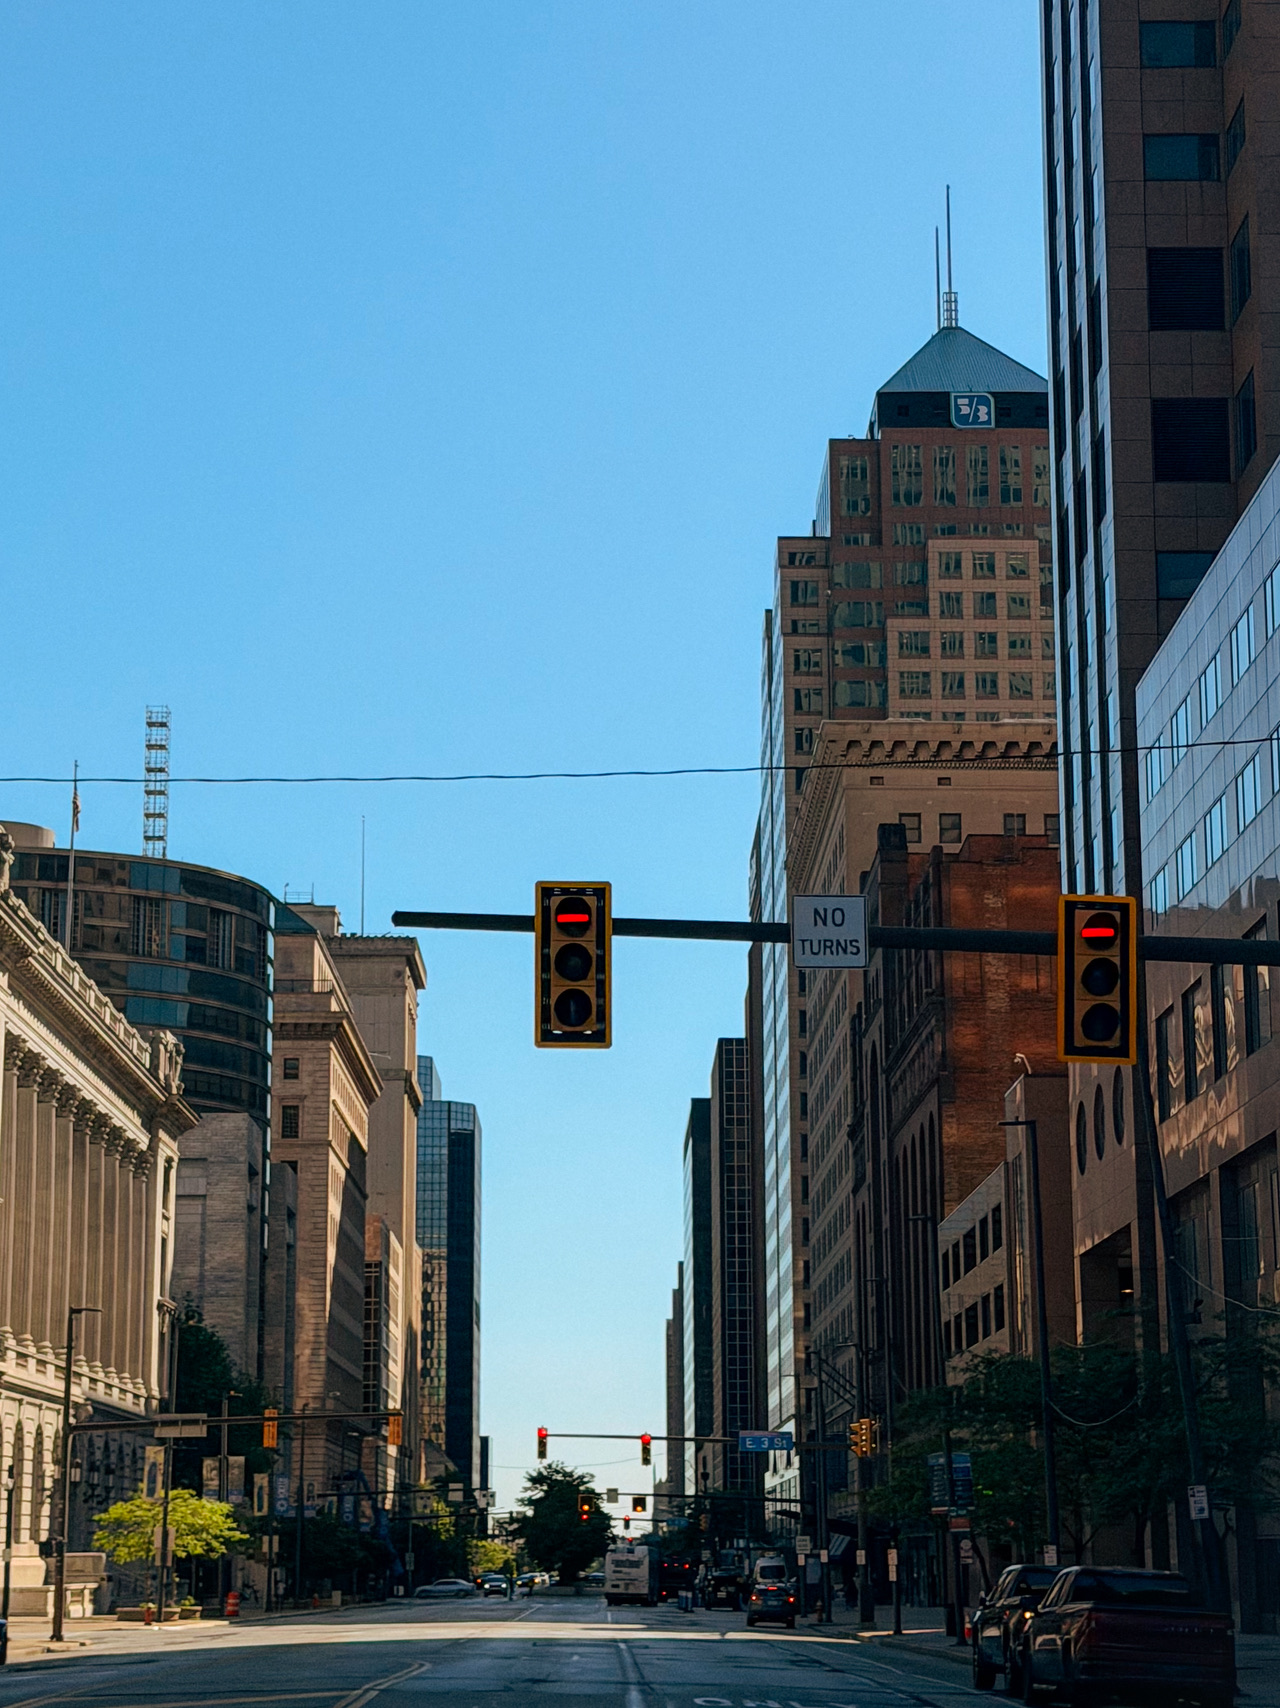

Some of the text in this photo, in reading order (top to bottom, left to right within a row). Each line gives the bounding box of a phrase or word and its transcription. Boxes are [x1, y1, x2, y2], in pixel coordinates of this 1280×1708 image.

[957, 396, 989, 423] 5/3
[813, 907, 846, 927] NO
[797, 938, 861, 956] TURNS
[745, 1437, 756, 1448] E
[760, 1437, 769, 1448] 3
